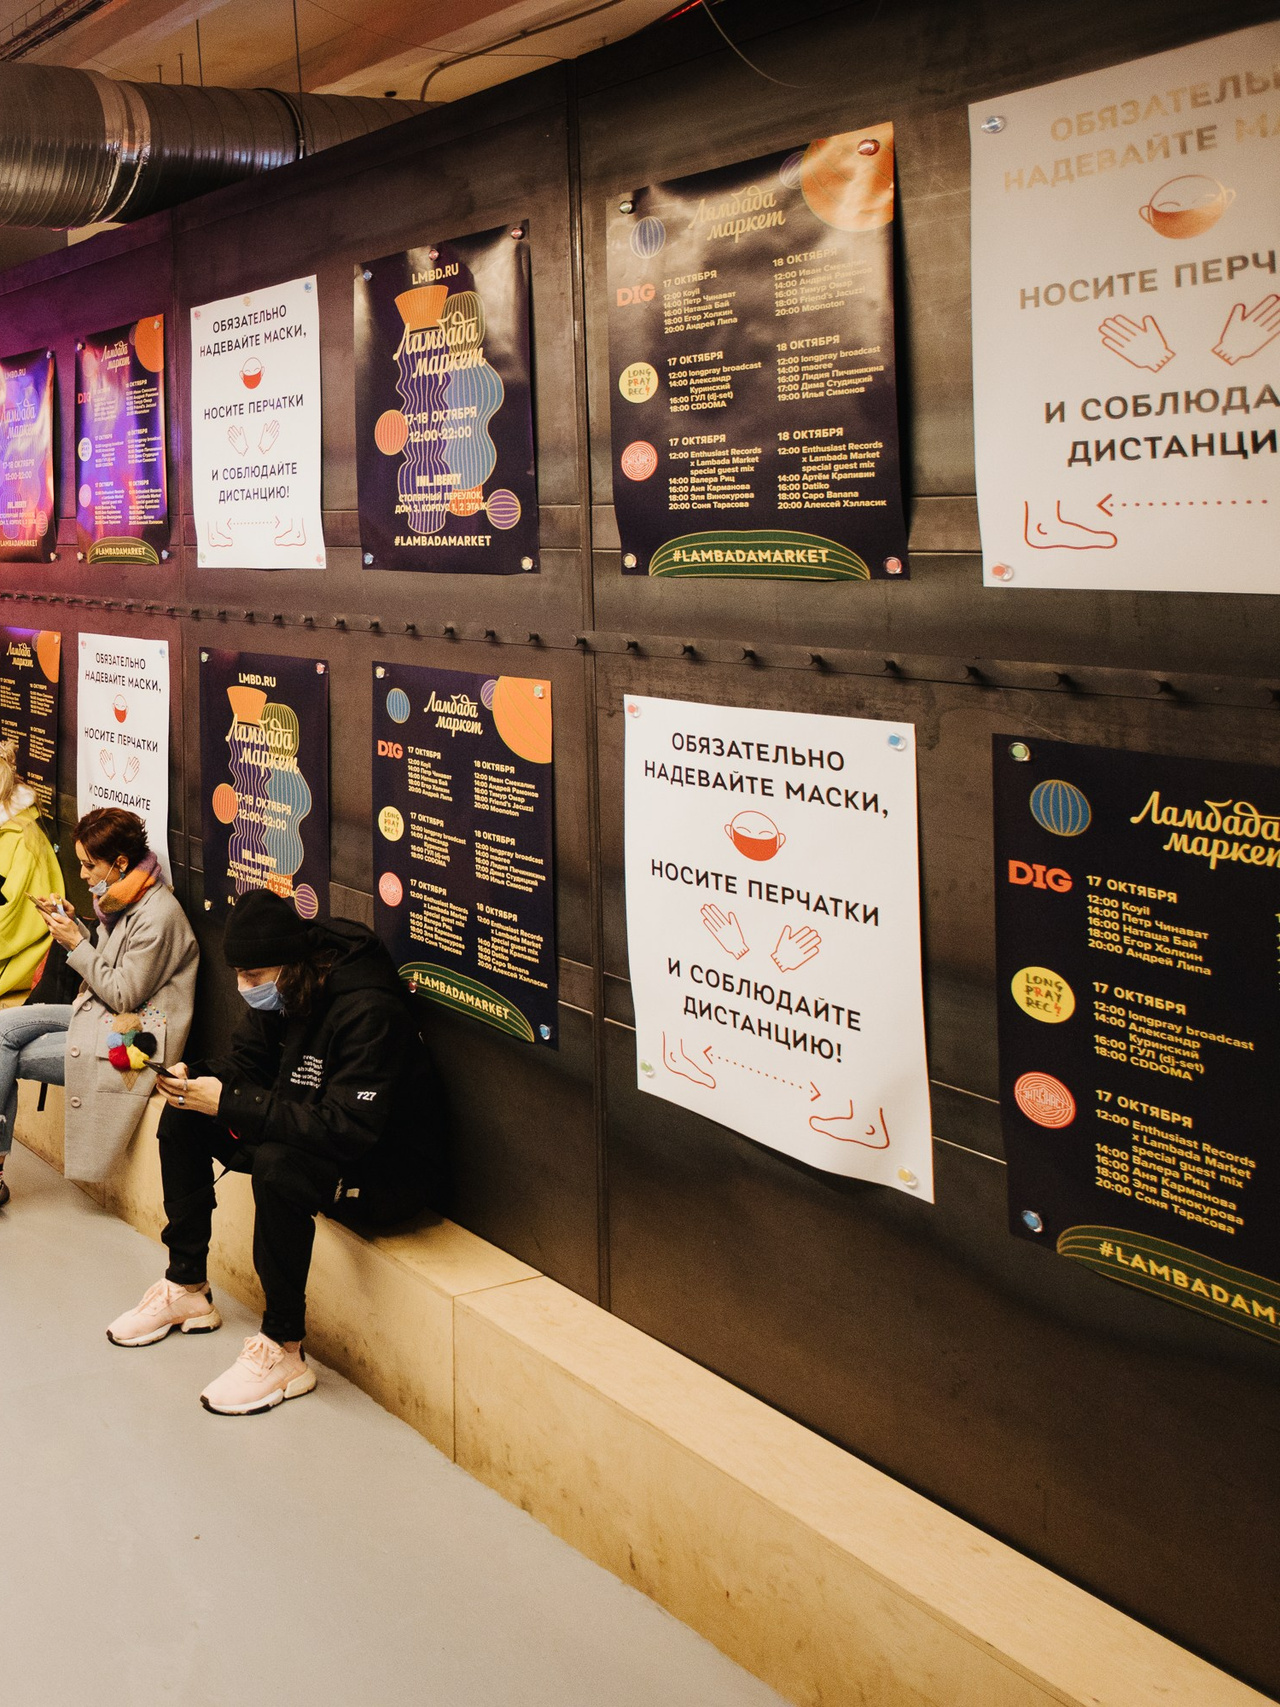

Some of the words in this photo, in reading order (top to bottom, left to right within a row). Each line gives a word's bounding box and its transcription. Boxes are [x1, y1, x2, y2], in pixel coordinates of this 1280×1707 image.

[1004, 124, 1218, 193] НАДЕВАЙТЕ
[706, 210, 786, 243] маркет
[412, 263, 459, 285] LMBD.RU
[1019, 267, 1158, 310] НОСИТЕ
[1174, 249, 1276, 288] ПЕРЧ
[616, 283, 656, 307] DIG
[212, 304, 287, 333] ОБЯЗАТЕЛЬНО
[200, 334, 261, 357] НАДЕВАЙТЕ
[264, 324, 307, 344] МАСКИ,
[392, 311, 479, 361] Ламбада
[412, 347, 487, 386] маркет
[204, 403, 244, 420] НОСИТЕ
[248, 393, 304, 414] ПЕРЧАТКИ
[404, 411, 429, 425] 17-18
[431, 406, 478, 422] ОКТЯБРЯ
[1043, 400, 1066, 424] И
[1080, 383, 1280, 422] СОБЛЮДА
[408, 426, 472, 443] 12:00-22:00
[777, 431, 790, 441] 18
[792, 427, 843, 440] ОКТЯБРЯ
[1067, 429, 1277, 467] ДИСТАНЦИ
[211, 469, 219, 481] И
[222, 461, 298, 481] СОБЛЮДАЙТЕ
[777, 482, 801, 491] 16:00
[801, 482, 830, 490] Datiko
[219, 485, 290, 504] ДИСТАНЦИЮ!
[777, 492, 801, 500] 18:00
[801, 491, 825, 500] Capo
[826, 490, 859, 498] Banana
[394, 535, 492, 547] #LAMBADAMARKET
[672, 549, 829, 564] #LAMBADAMARKET
[95, 652, 146, 670] ОБЯЗАТЕЛЬНО
[85, 670, 126, 687] НАДЕВАЙТЕ
[127, 677, 162, 694] МАСКИ,
[238, 672, 277, 688] LMBD.RU
[423, 690, 478, 718] Ламбада
[84, 726, 115, 743] НОСИТЕ
[117, 733, 159, 753] ПЕРЧАТКИ
[225, 713, 294, 751] Ламбада
[434, 715, 483, 738] маркет
[239, 747, 300, 777] маркет
[377, 739, 403, 760] DIG
[407, 745, 414, 753] 17
[414, 747, 441, 759] ОКТЯБРЯ
[671, 733, 844, 770] ОБЯЗАТЕЛЬНО
[473, 759, 481, 768] 18
[481, 761, 515, 774] ОКТЯБРЯ
[93, 785, 151, 811] СОБЛЮДАЙТЕ
[235, 791, 254, 806] 17-18
[256, 797, 292, 816] ОКТЯБРЯ
[644, 761, 774, 796] НАДЕВАЙТЕ
[785, 781, 888, 817] МАСКИ,
[238, 809, 287, 831] 12:00-22:00
[1129, 790, 1280, 842] Ламбада
[651, 859, 737, 894] НОСИТЕ
[748, 880, 878, 925] ПЕРЧАТКИ
[1008, 859, 1073, 893] DIG
[1086, 875, 1102, 886] 17
[1106, 879, 1177, 903] ОКТЯБРЯ
[1087, 895, 1119, 908] 12:00
[1121, 901, 1150, 915] Koyil
[1086, 905, 1119, 919] 14:00
[1122, 912, 1152, 928] Петр
[1154, 920, 1209, 939] Чинават
[1087, 916, 1120, 931] 16:00
[1122, 924, 1170, 942] Наташа
[1172, 935, 1198, 949] Бай
[1087, 928, 1120, 942] 18:00
[1123, 935, 1152, 951] Егор
[1155, 943, 1203, 961] Холкин
[1087, 938, 1123, 954] 20:00
[1125, 947, 1173, 966] Андрей
[1176, 960, 1211, 975] Липа
[412, 971, 510, 1020] #LAMBADAMARKET
[668, 957, 681, 977] И
[690, 965, 861, 1030] СОБЛЮДАЙТЕ
[1025, 973, 1064, 991] LONG
[1025, 984, 1063, 1004] PRAY
[1092, 981, 1109, 994] 17
[1113, 987, 1186, 1015] ОКТЯБРЯ
[683, 996, 842, 1062] ДИСТАНЦИЮ!
[1092, 1001, 1126, 1016] 12:00
[1128, 1010, 1182, 1033] longpray
[1185, 1025, 1254, 1050] broadcast
[1093, 1012, 1126, 1028] 14:00
[1128, 1022, 1201, 1048] Александр
[1093, 1034, 1127, 1050] 16:00
[1129, 1044, 1156, 1059] ГУЛ
[1158, 1053, 1204, 1074] (dj-set)
[1128, 1033, 1199, 1059] Куринский
[356, 1091, 377, 1101] 727
[1095, 1089, 1112, 1102] 17
[1116, 1096, 1192, 1128] ОКТЯБРЯ
[1095, 1109, 1129, 1126] 12:00
[1132, 1120, 1198, 1149] Enthusiast
[1201, 1142, 1256, 1168] Records
[1095, 1143, 1129, 1161] 14:00
[1132, 1155, 1180, 1178] Валера
[1183, 1172, 1210, 1190] Риц
[1131, 1133, 1139, 1142] x
[1142, 1135, 1201, 1162] Lambada
[1204, 1155, 1251, 1179] Market
[1131, 1145, 1176, 1165] special
[1179, 1161, 1216, 1179] guest
[1219, 1174, 1243, 1188] mix
[1095, 1154, 1130, 1172] 16:00
[1131, 1167, 1158, 1182] Аня
[1161, 1176, 1237, 1210] Карманова
[1095, 1165, 1130, 1184] 18:00
[1132, 1178, 1158, 1194] Эля
[1160, 1188, 1244, 1225] Винокурова
[1095, 1176, 1132, 1196] 20:00
[1134, 1191, 1168, 1210] Соня
[1172, 1204, 1235, 1234] Тарасова
[1099, 1241, 1280, 1325] #LAMBADAM
